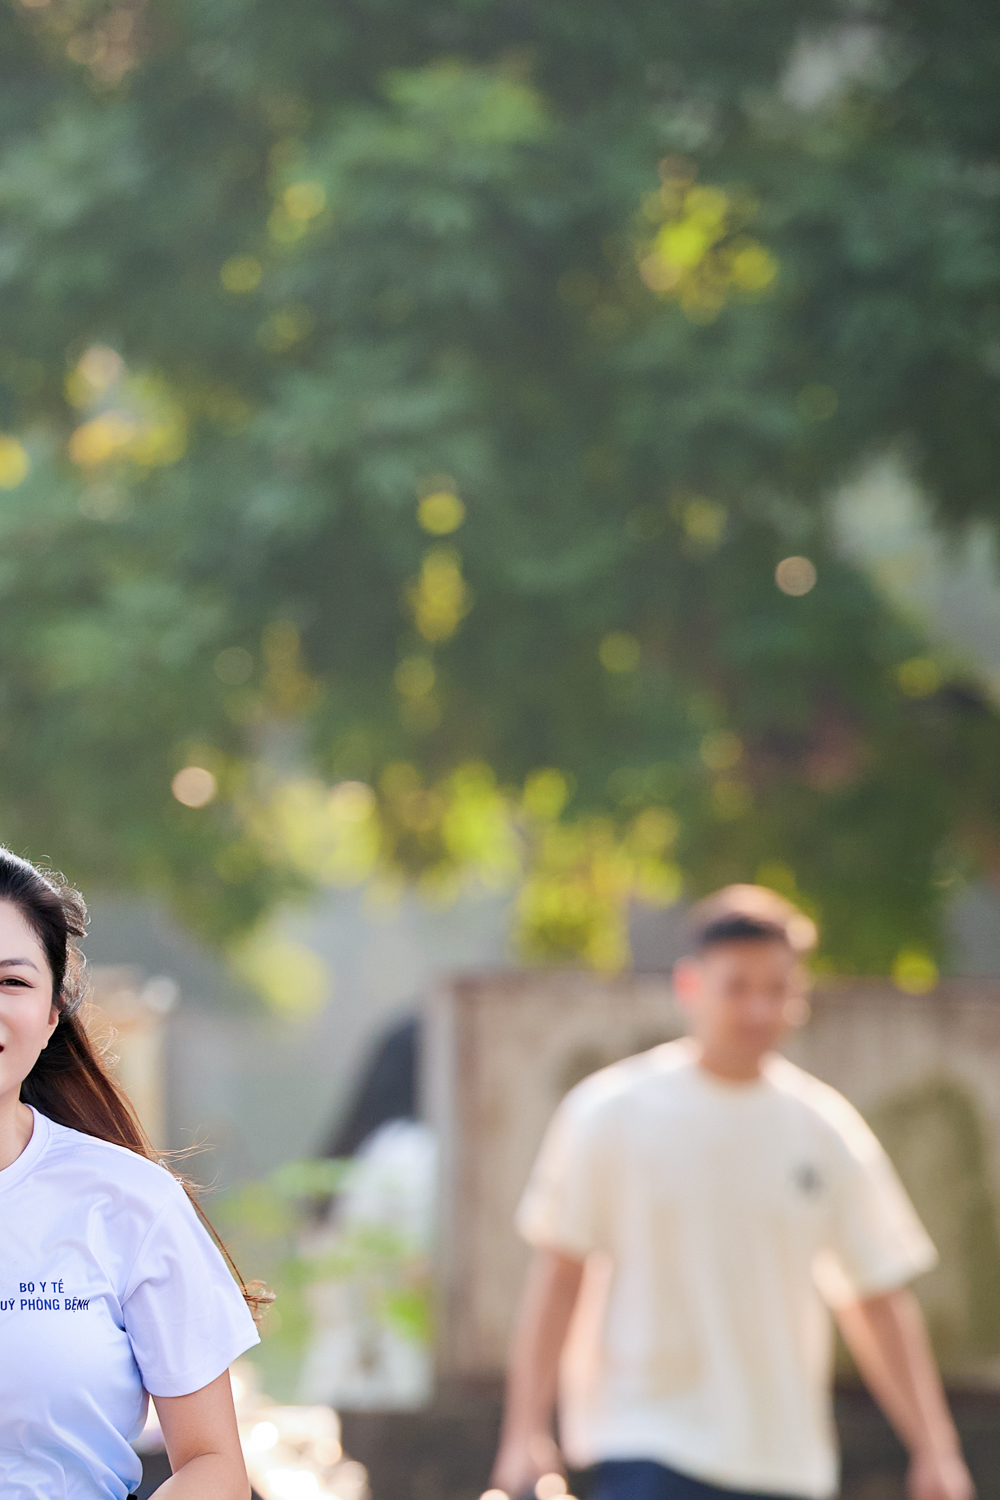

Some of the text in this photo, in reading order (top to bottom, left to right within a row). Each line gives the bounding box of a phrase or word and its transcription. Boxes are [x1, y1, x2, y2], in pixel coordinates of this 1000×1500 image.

[19, 1279, 65, 1294] BỘ Y TẾ
[20, 1297, 60, 1310] PHÒNG
[65, 1296, 90, 1313] BỆNH
